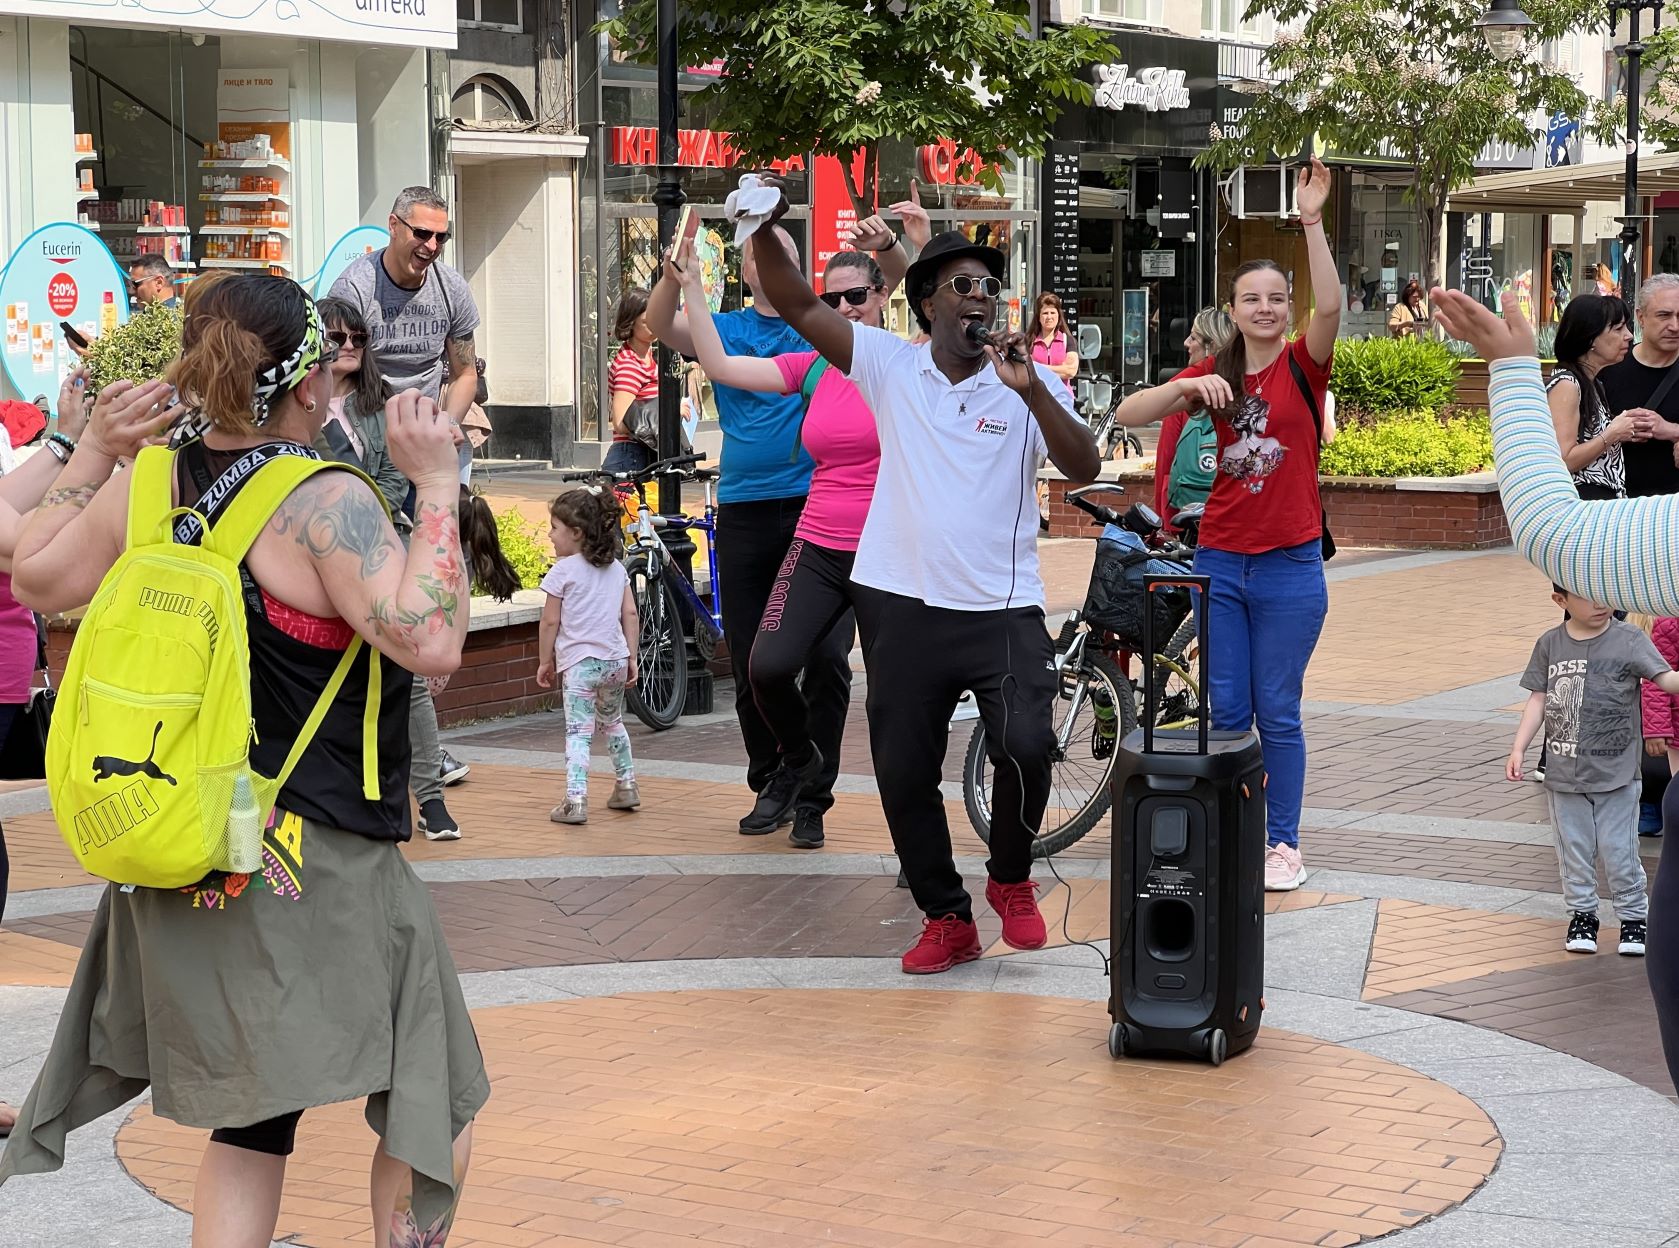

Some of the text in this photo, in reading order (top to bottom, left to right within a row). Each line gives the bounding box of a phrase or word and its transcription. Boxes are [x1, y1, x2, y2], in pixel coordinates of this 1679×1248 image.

[224, 78, 245, 88] лице
[254, 78, 273, 86] тяло
[43, 240, 81, 256] Eucerin
[48, 282, 76, 297] -20%
[382, 304, 437, 320] DRY GOODS
[371, 319, 448, 340] TOM TAILOR
[983, 422, 1008, 432] ЖИВЕЙ
[202, 449, 266, 512] ZUMBA
[778, 540, 804, 578] KEEP
[139, 587, 194, 616] PUMA
[761, 580, 791, 632] GOING
[1548, 659, 1588, 680] DESE
[73, 779, 160, 856] PUMA
